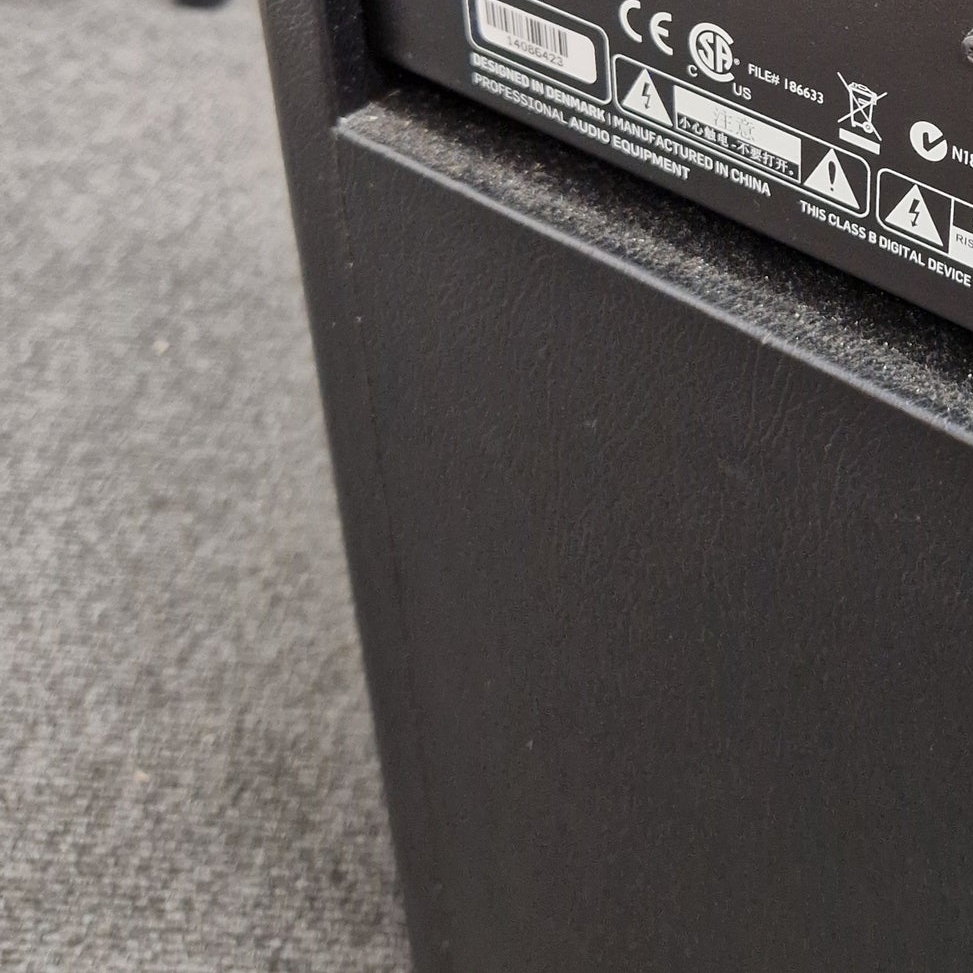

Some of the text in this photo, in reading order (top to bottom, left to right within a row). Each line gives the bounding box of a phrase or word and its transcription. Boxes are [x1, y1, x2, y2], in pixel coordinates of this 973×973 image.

[506, 35, 565, 68] 14086423
[748, 63, 824, 104] FILE# 186633
[470, 51, 772, 197] DESIGNED IN DENMARK MANUFACTURED IN CHINA
[732, 82, 752, 101] US
[471, 71, 691, 181] PROFESSIONAL AUDIO EQUIPMENT
[799, 199, 827, 221] THIS
[828, 212, 867, 240] CLASS
[867, 229, 877, 245] B
[878, 233, 926, 268] DIGITAL
[927, 256, 972, 288] DEVICE
